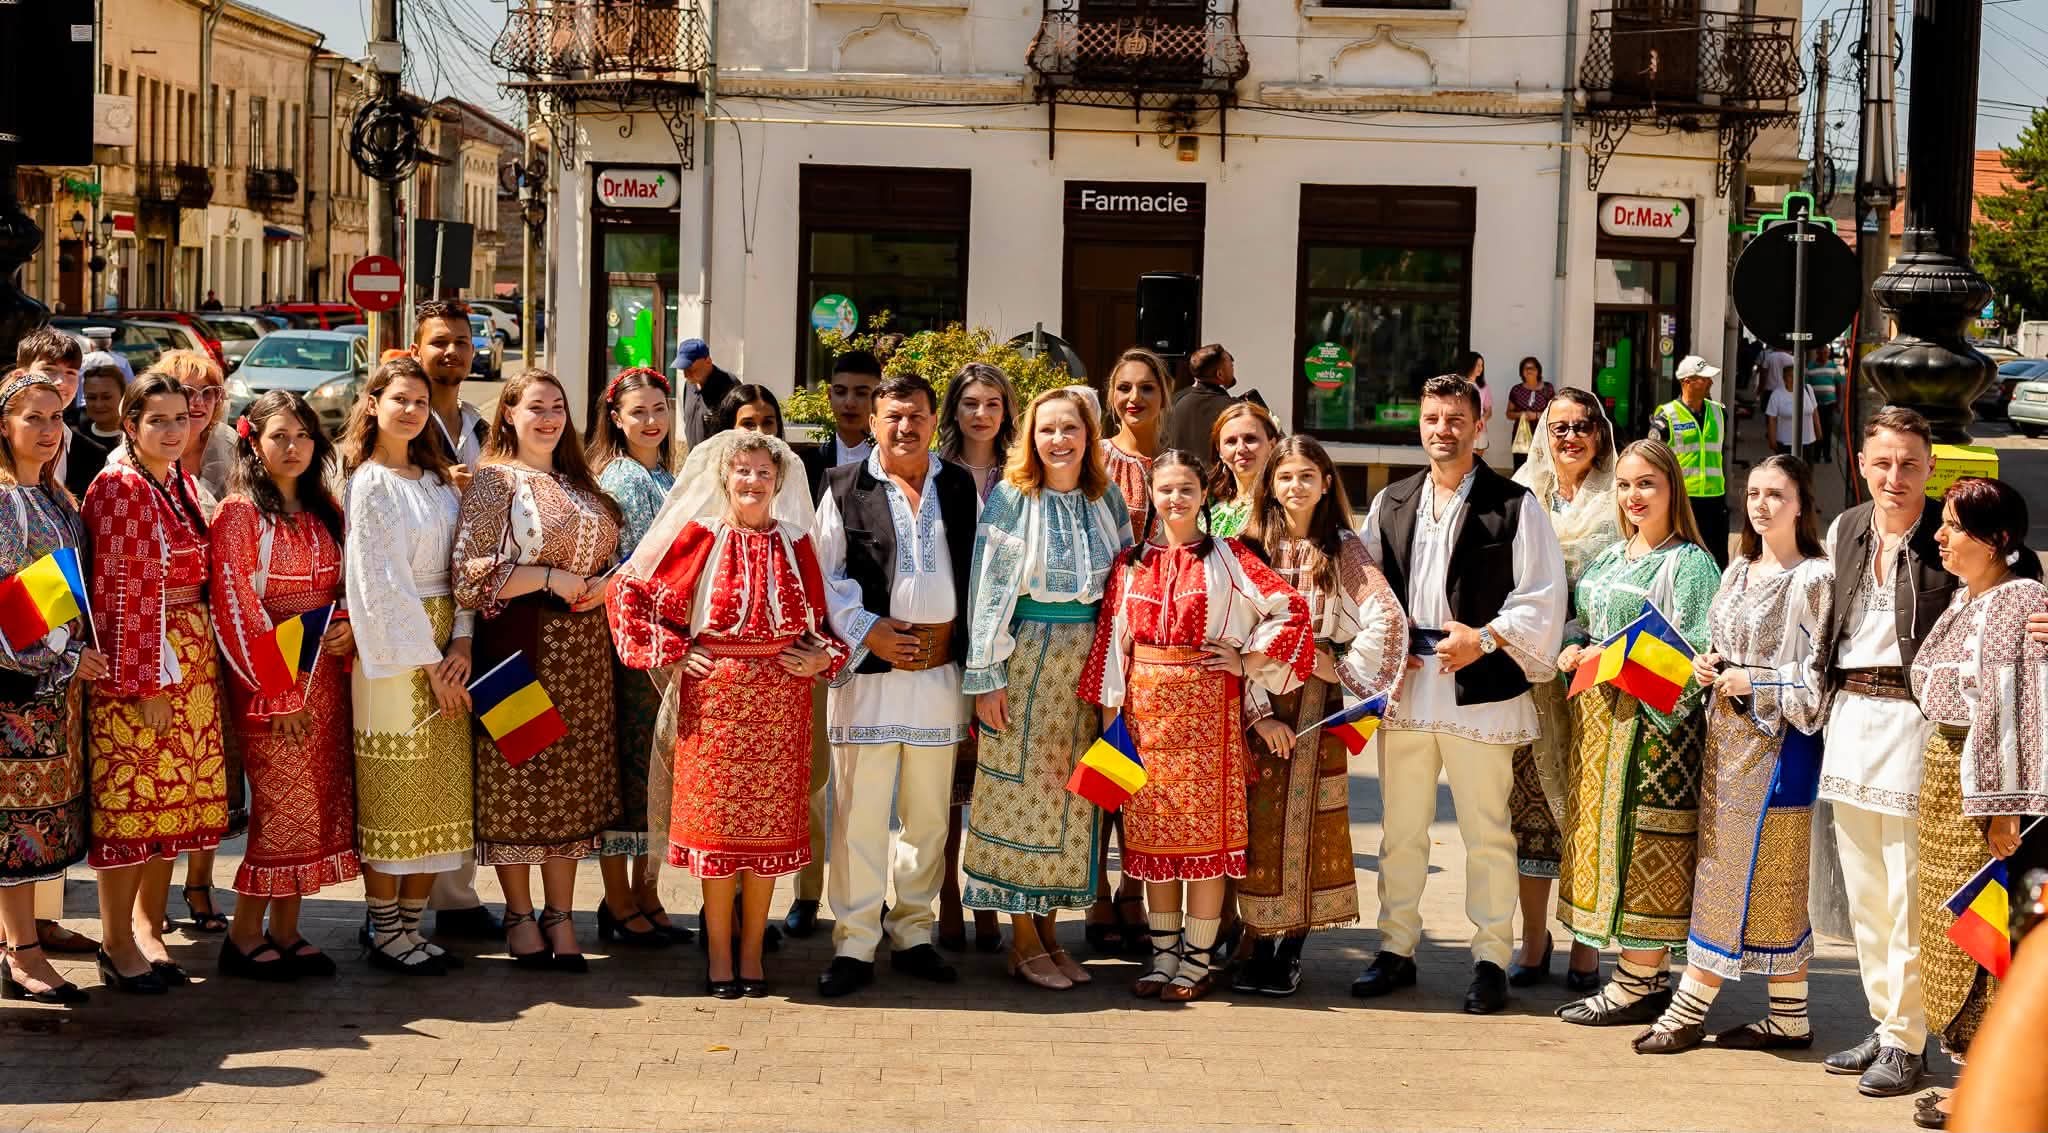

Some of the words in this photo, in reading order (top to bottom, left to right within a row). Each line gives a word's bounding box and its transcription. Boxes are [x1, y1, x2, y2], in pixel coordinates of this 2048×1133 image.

[603, 178, 658, 198] Dr.Max
[1081, 189, 1188, 212] Farmacie
[1614, 206, 1673, 228] Dr.Max
